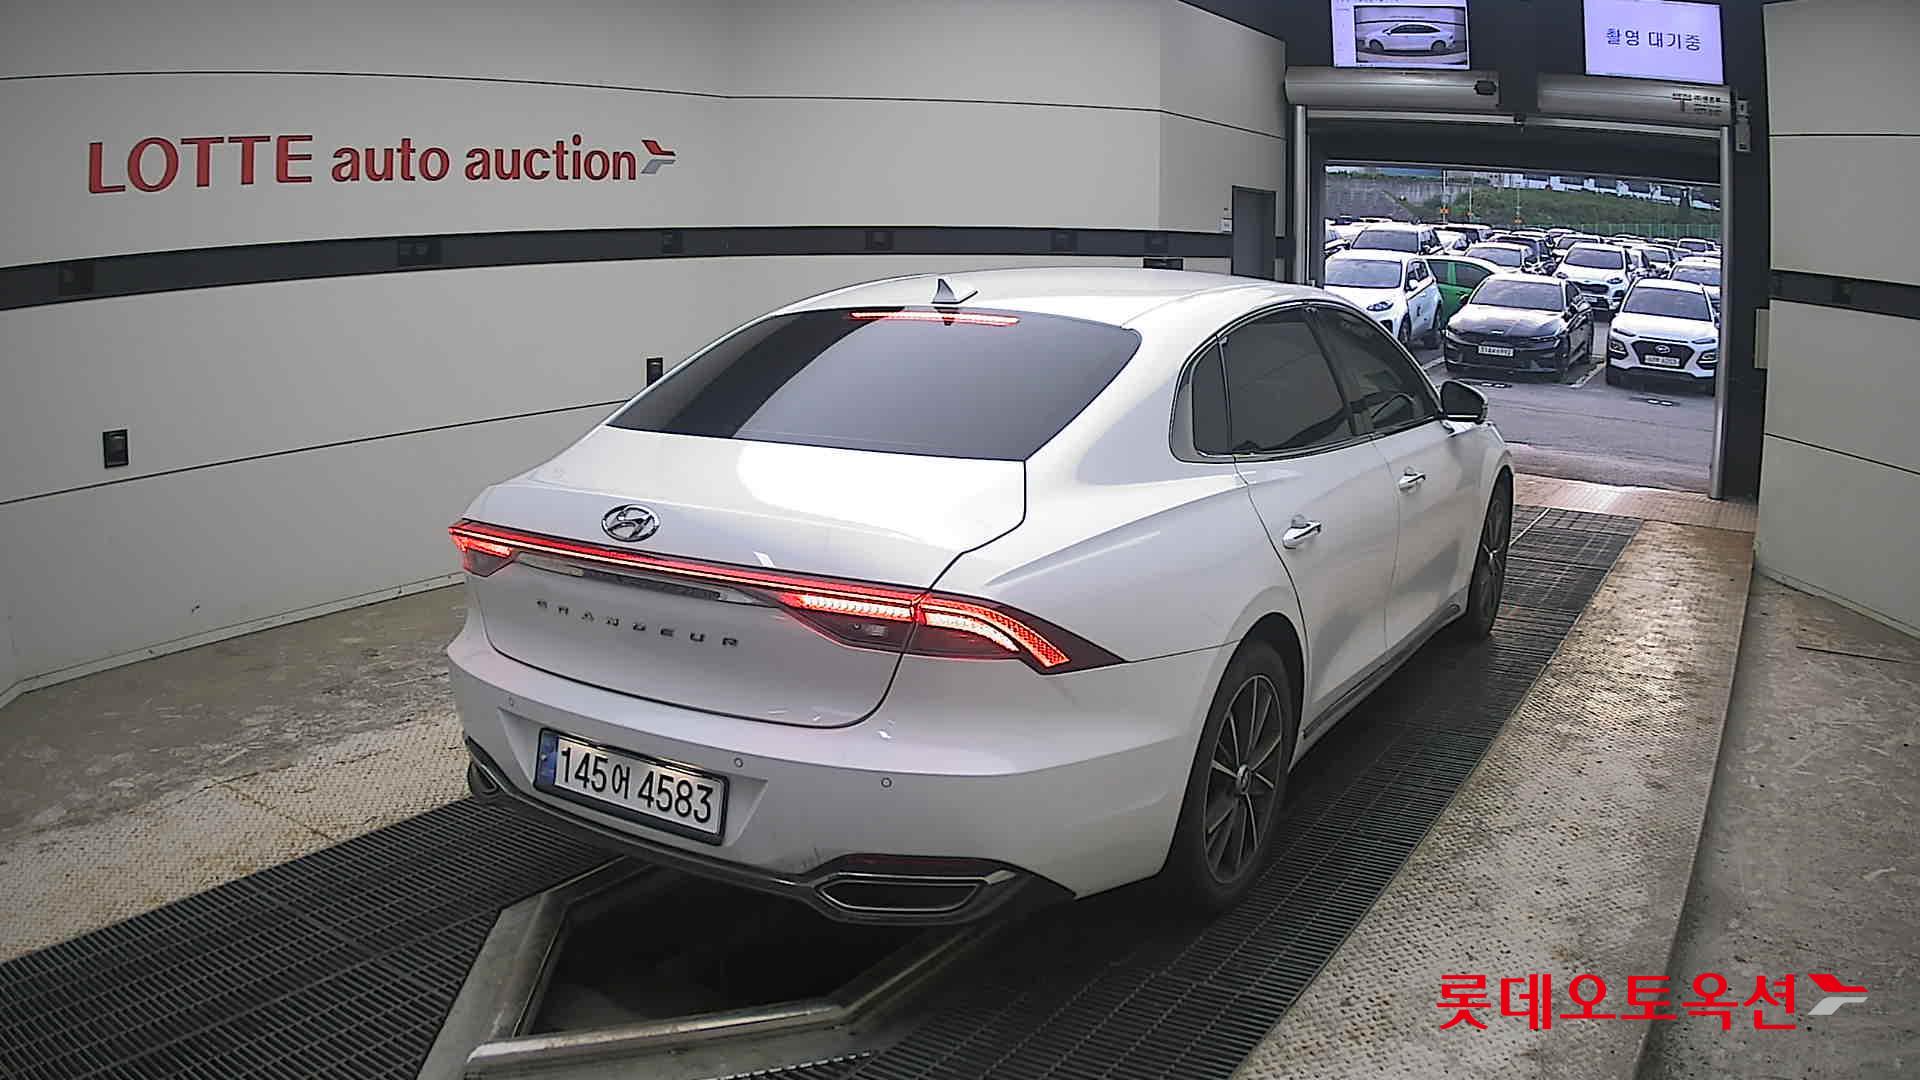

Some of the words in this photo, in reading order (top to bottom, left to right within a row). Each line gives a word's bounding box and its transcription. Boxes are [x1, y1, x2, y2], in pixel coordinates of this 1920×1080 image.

[1648, 31, 1701, 52] 대기중
[88, 134, 313, 194] LOTTE
[331, 138, 450, 182] auto
[464, 134, 637, 181] auction
[561, 747, 631, 800] 145어
[637, 770, 714, 824] 4583
